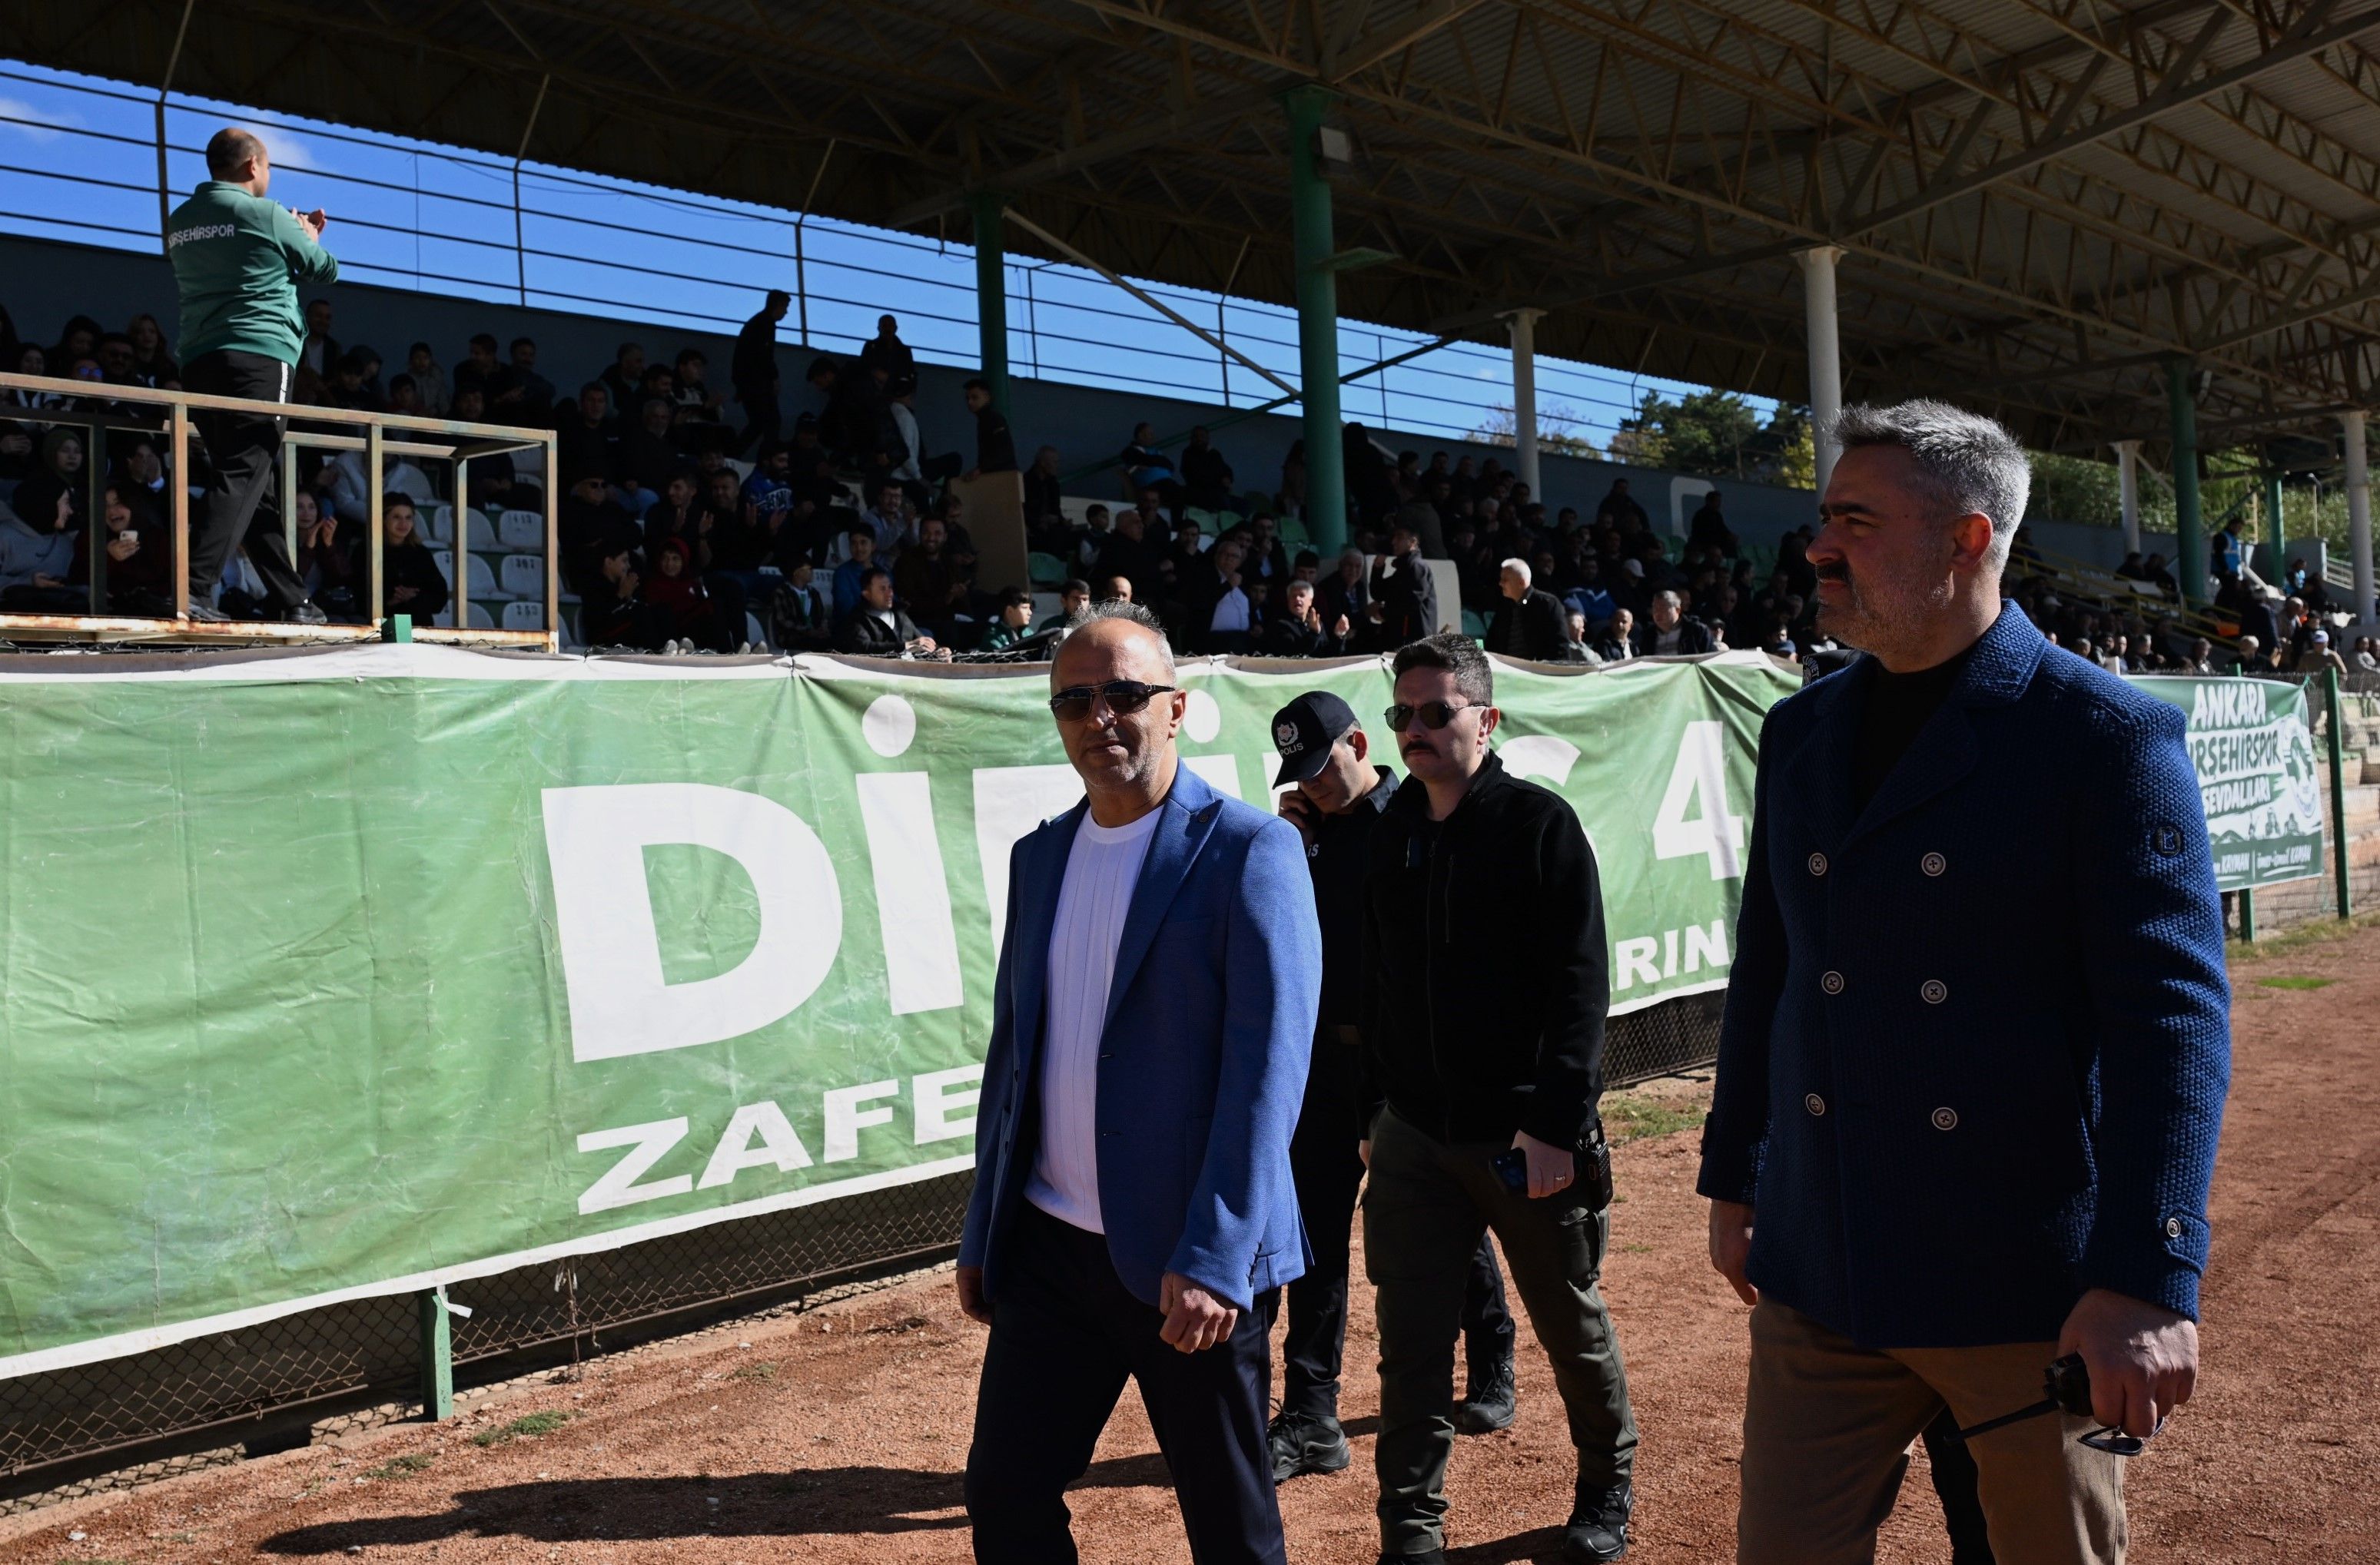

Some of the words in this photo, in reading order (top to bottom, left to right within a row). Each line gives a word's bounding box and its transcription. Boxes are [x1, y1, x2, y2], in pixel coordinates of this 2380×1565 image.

[2190, 682, 2266, 731] ANKARA
[577, 1063, 984, 1215] ZAFE
[1610, 920, 1729, 992] RIN
